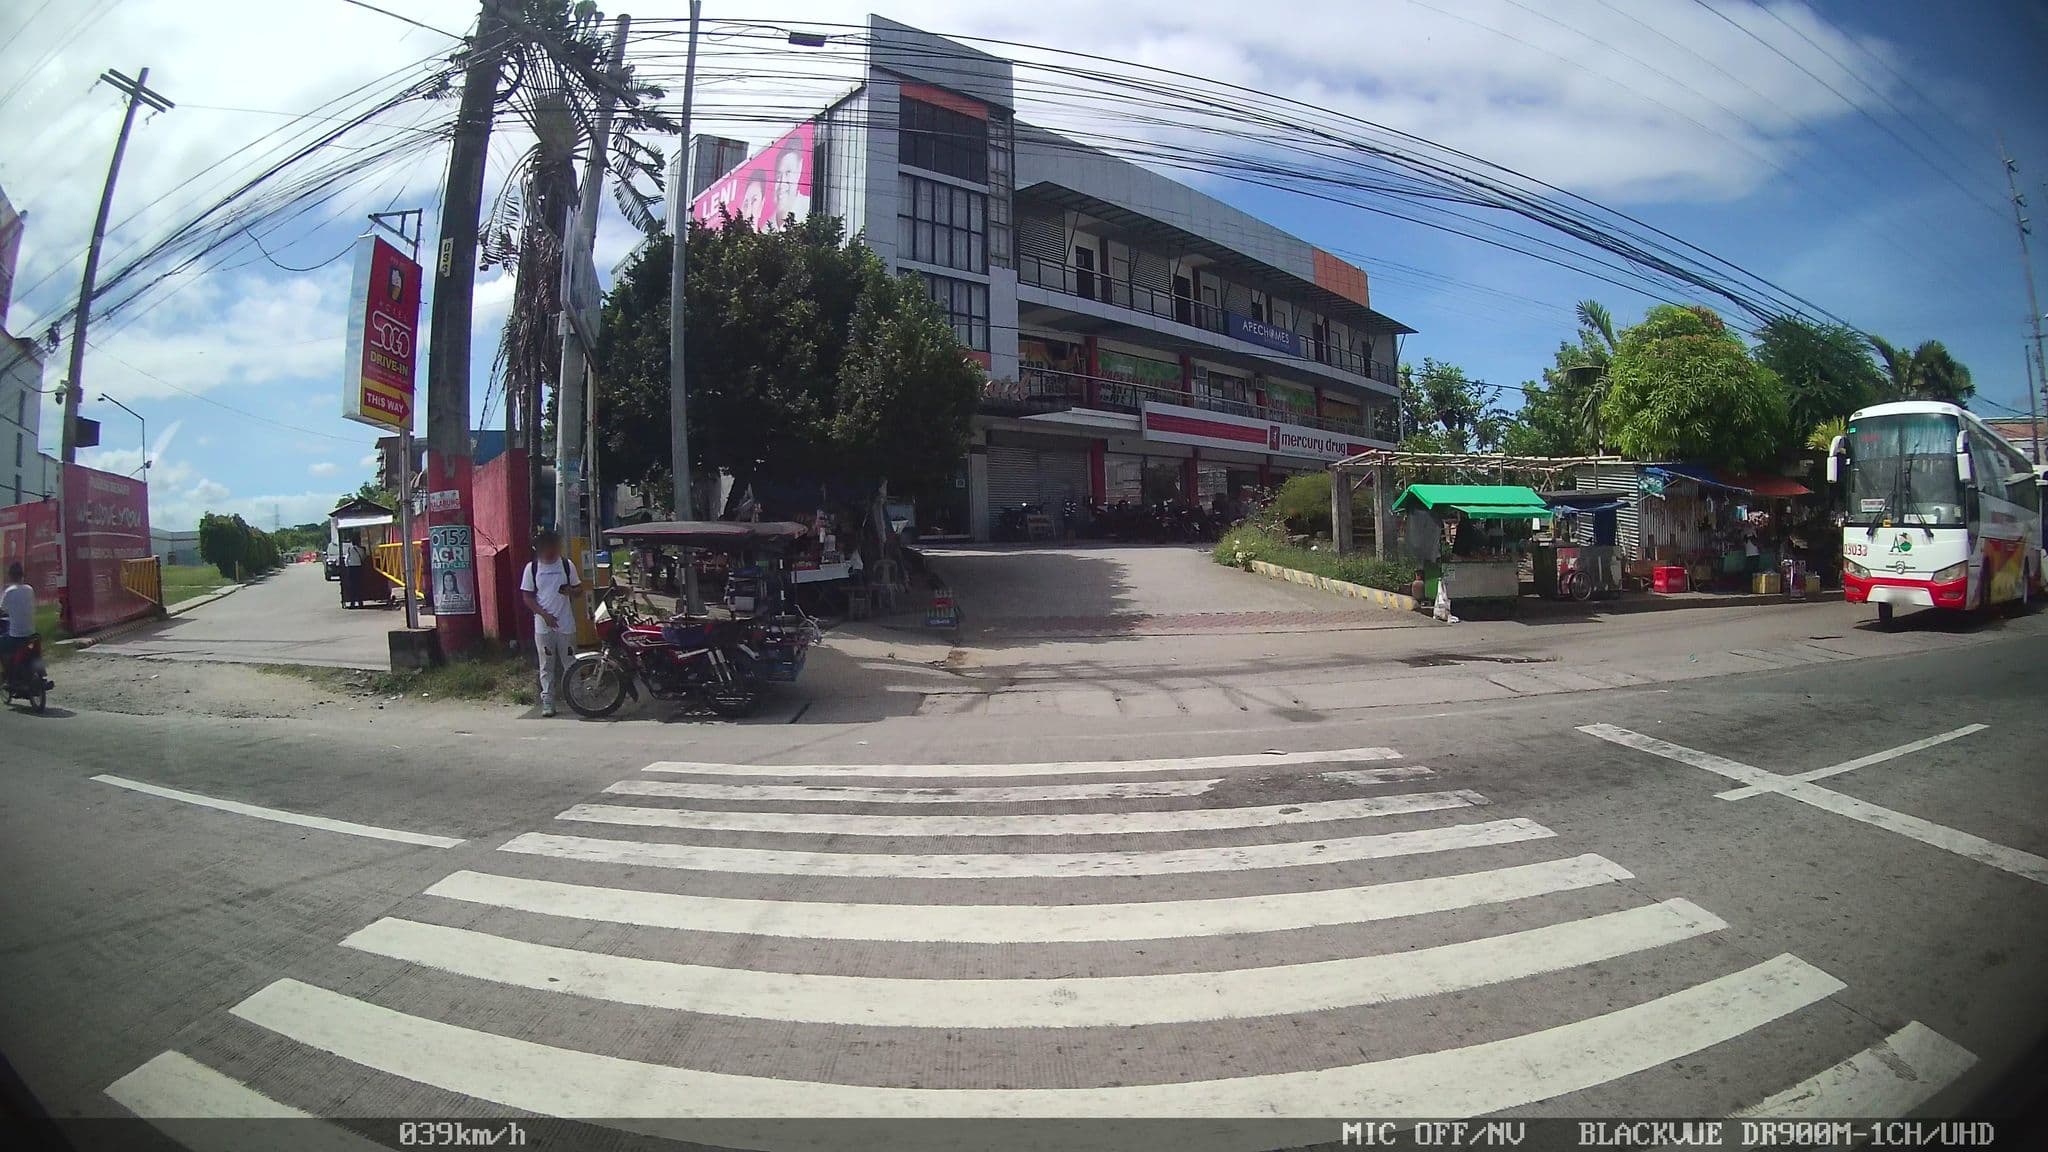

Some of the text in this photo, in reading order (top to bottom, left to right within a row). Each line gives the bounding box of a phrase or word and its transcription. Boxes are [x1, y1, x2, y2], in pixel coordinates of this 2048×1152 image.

[702, 180, 738, 220] LENI
[370, 310, 411, 358] SOGO
[369, 350, 409, 377] DRIVE-IN
[366, 393, 404, 414] THIS WAY
[1281, 433, 1324, 453] mercury
[1325, 438, 1346, 456] drug
[432, 547, 470, 562] AGRI
